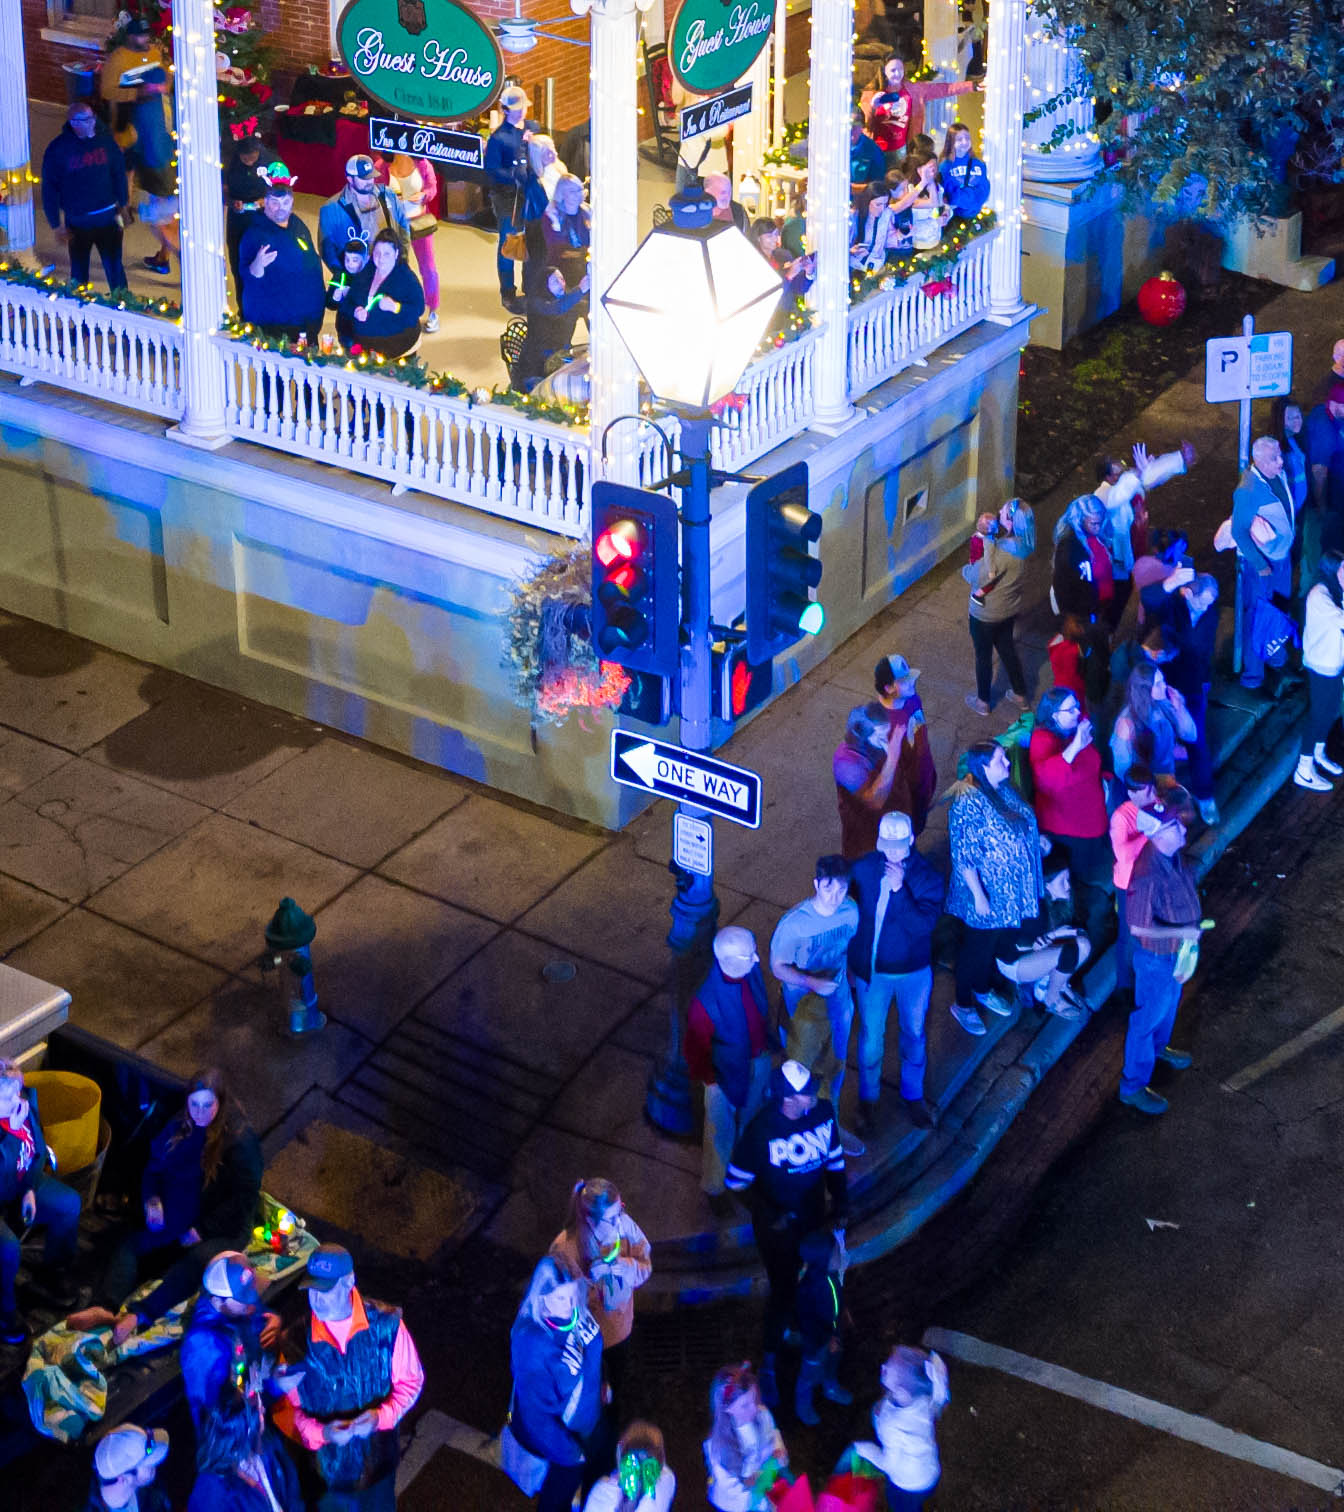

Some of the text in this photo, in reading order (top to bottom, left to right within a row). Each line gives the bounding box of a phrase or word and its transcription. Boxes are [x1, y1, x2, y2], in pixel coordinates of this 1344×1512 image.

[353, 27, 493, 88] Guest House
[680, 2, 771, 74] Guest House
[684, 98, 752, 138] Inn & Restaurant
[374, 126, 479, 163] Inn & Restaurant
[1221, 350, 1239, 373] P
[657, 760, 742, 804] ONE WAY
